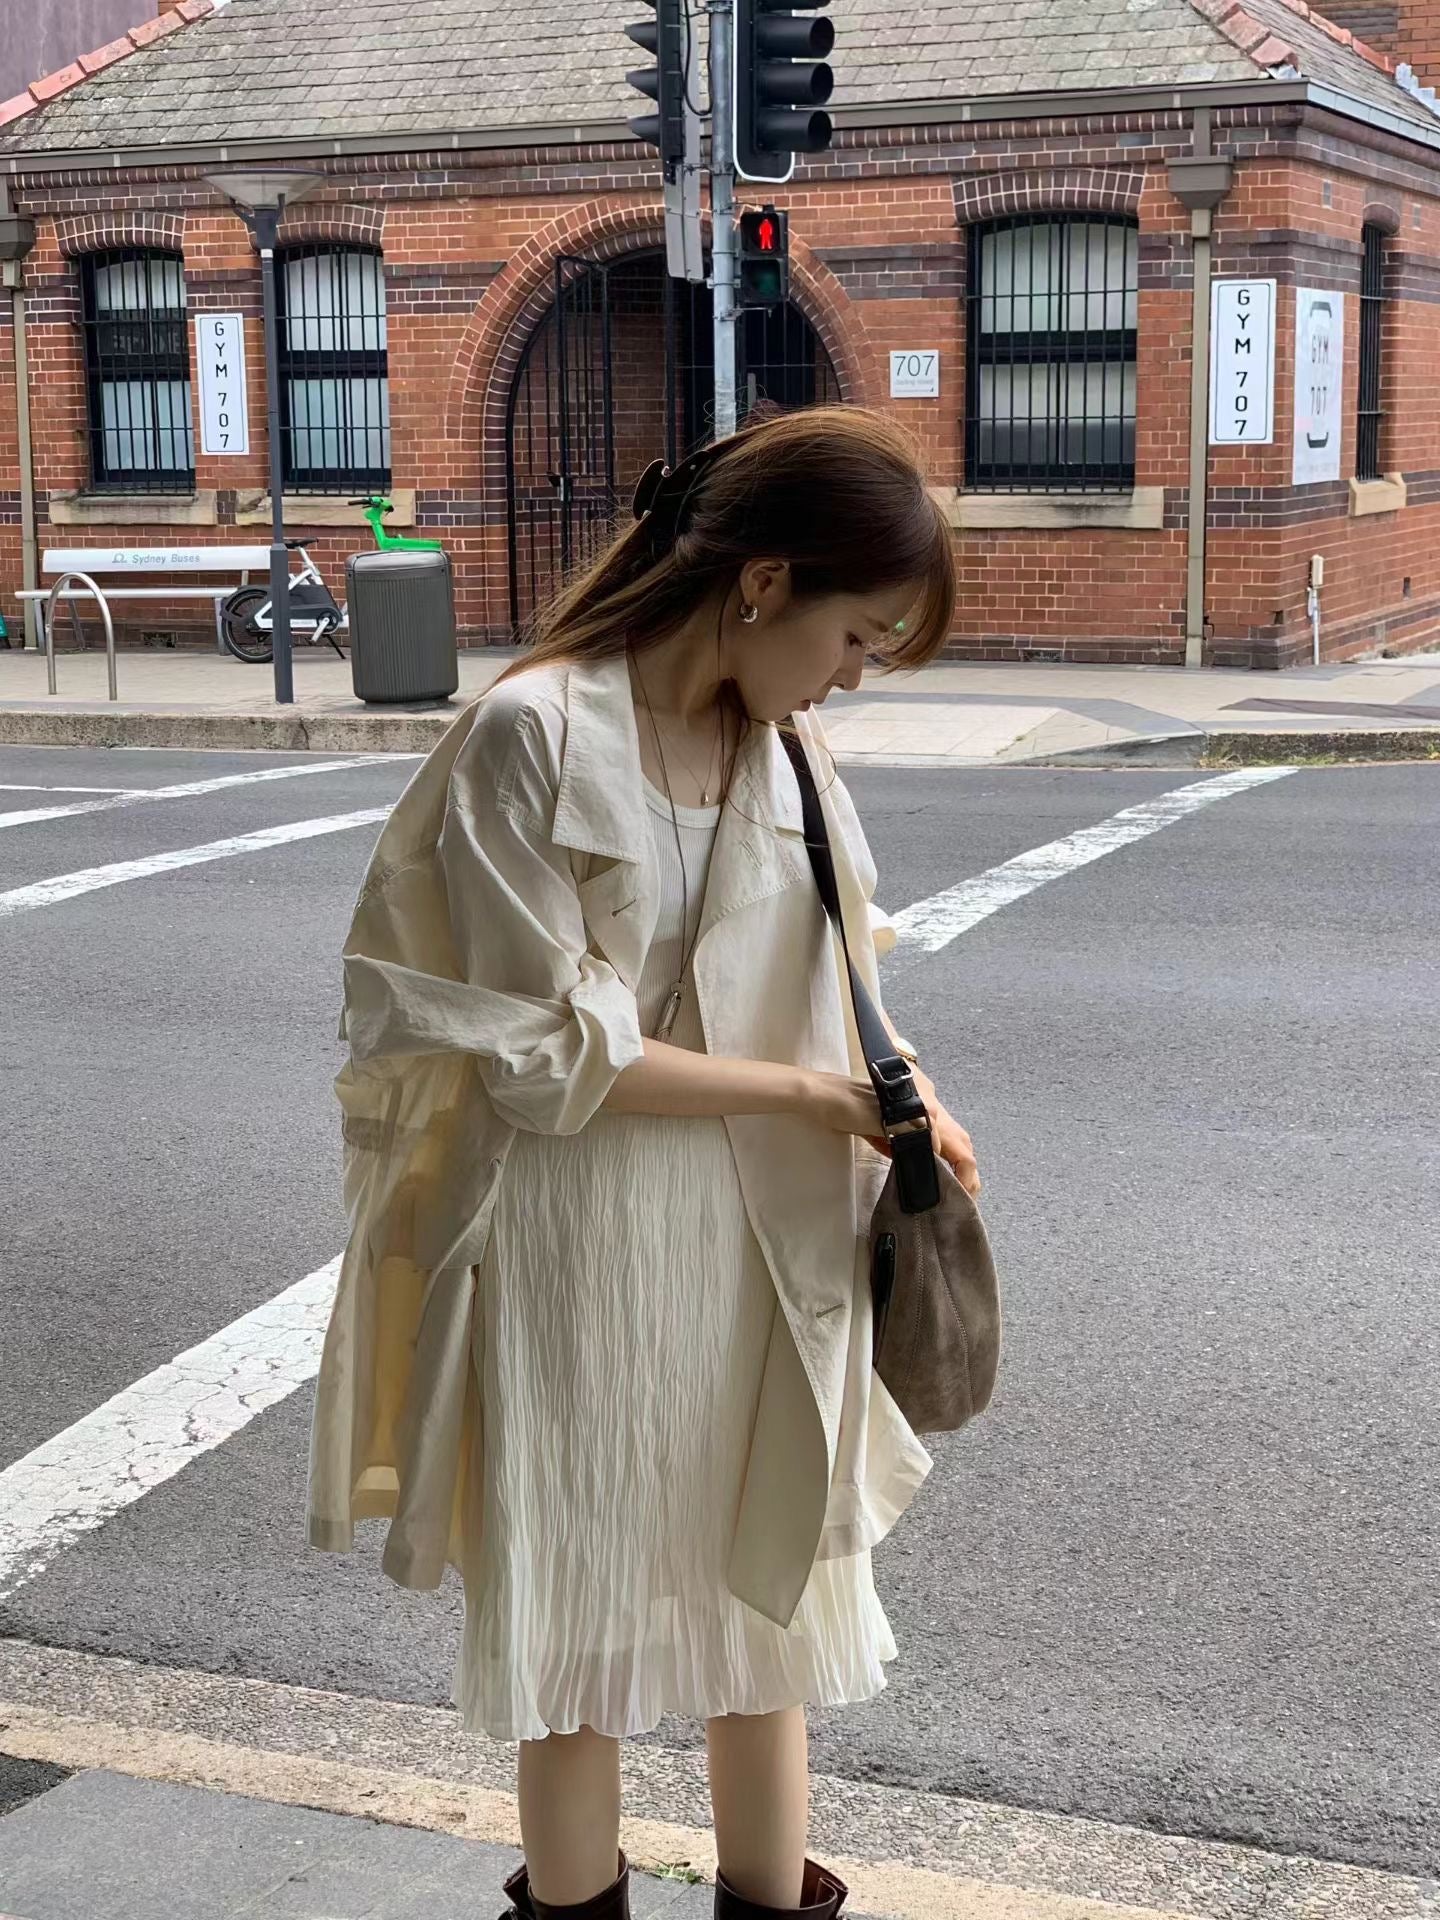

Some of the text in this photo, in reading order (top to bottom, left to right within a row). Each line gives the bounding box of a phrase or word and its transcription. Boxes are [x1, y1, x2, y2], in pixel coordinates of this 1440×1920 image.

[214, 321, 229, 449] GYM 707
[893, 354, 936, 377] 707
[1234, 289, 1251, 436] GYM 707
[131, 553, 201, 566] Sydney Buses
